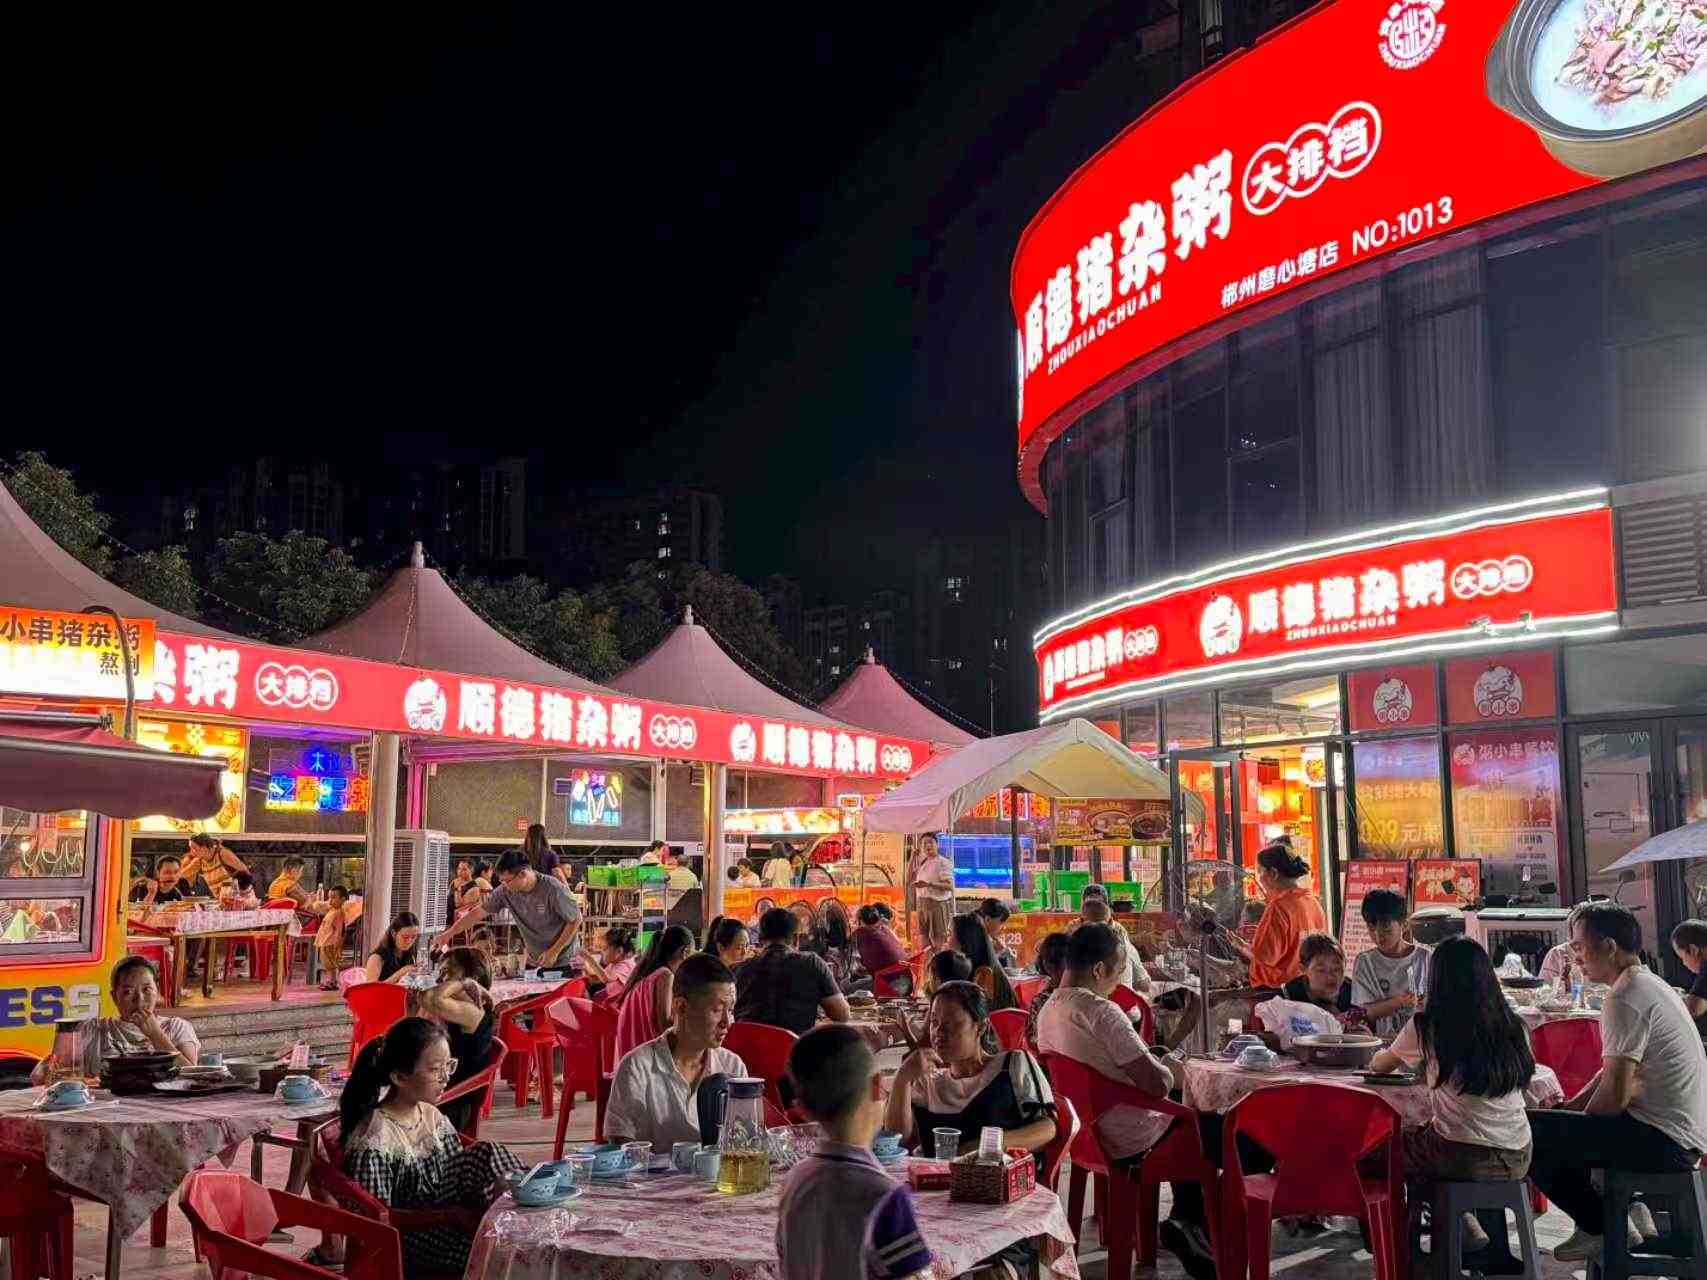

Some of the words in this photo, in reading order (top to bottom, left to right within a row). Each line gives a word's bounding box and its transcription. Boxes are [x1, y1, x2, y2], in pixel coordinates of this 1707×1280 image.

[1247, 109, 1374, 210] 大排档
[1352, 196, 1453, 256] NO:1013
[1048, 281, 1162, 376] ZHOUXIAOCHUAN
